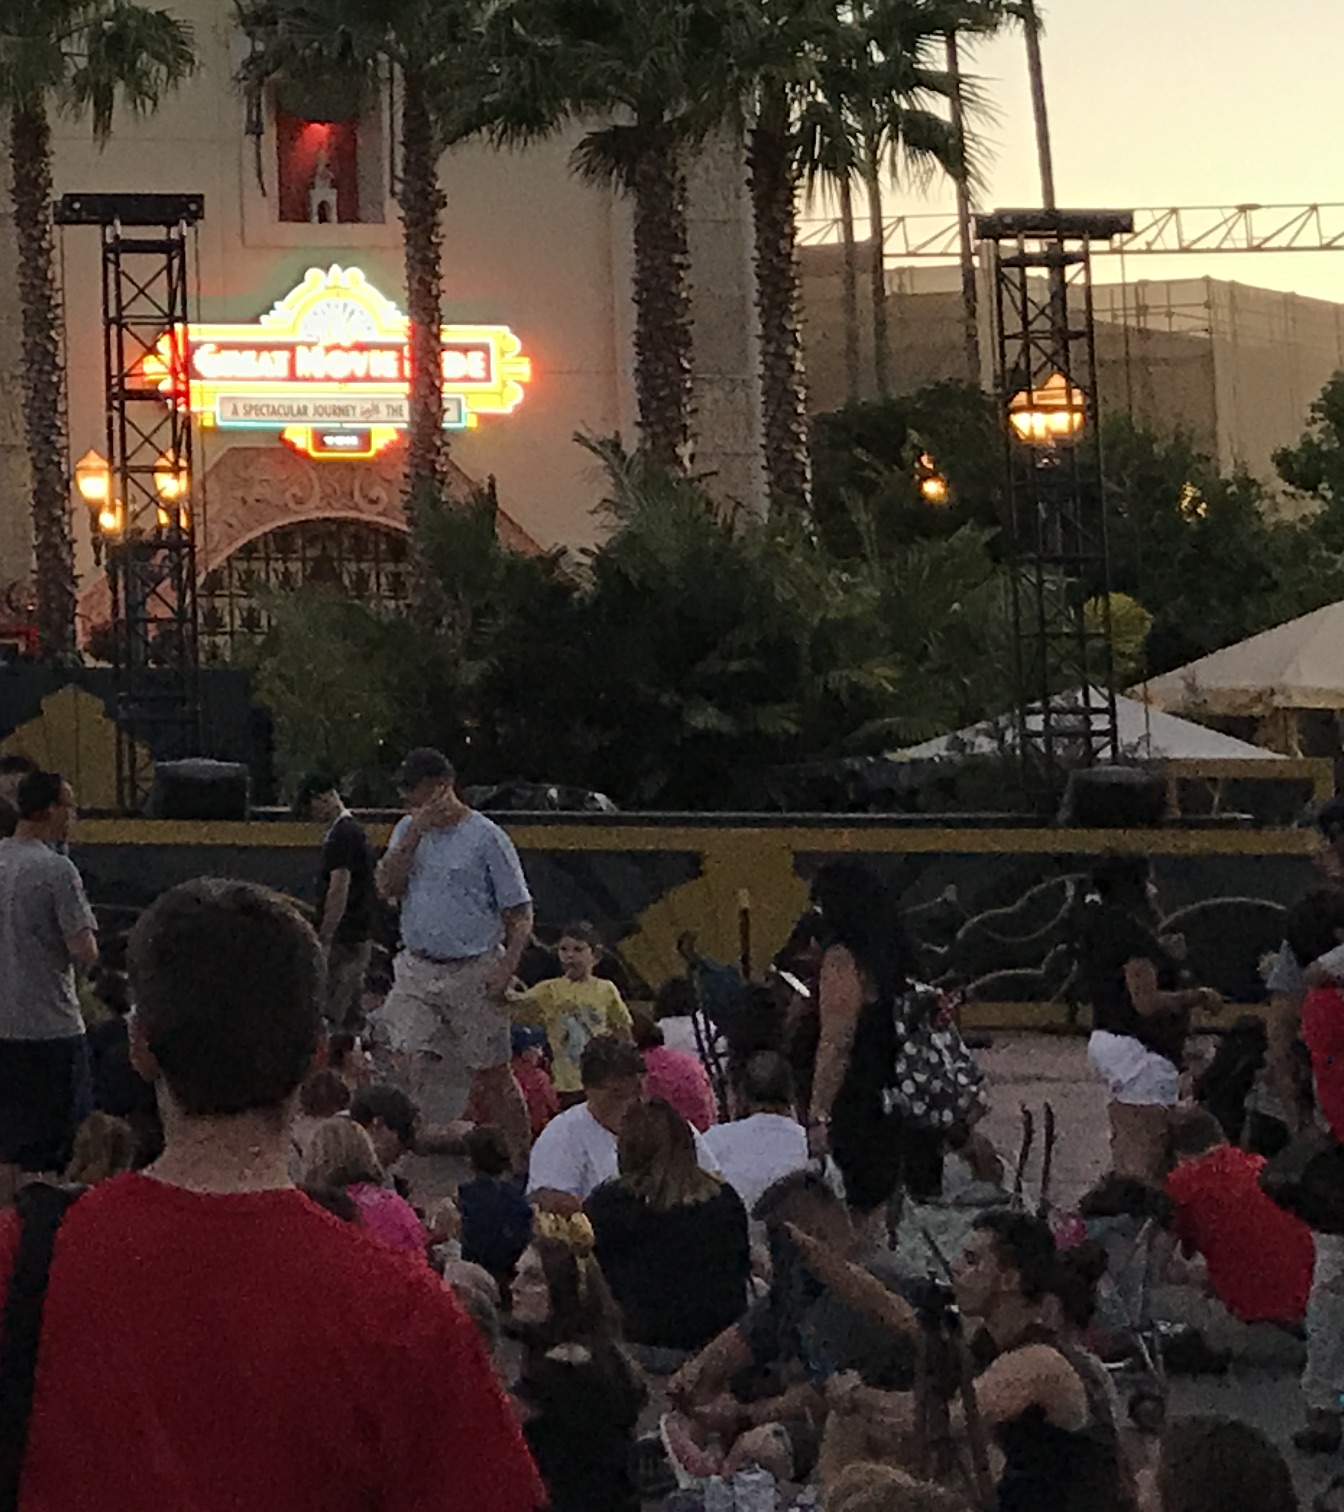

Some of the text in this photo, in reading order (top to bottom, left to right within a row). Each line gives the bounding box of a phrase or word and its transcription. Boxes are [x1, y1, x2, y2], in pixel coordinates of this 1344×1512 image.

[297, 346, 395, 377] MOVIE
[231, 403, 239, 416] A
[243, 403, 308, 417] SPECTACULAR
[313, 404, 356, 418] JOURNEY
[386, 404, 404, 417] THE
